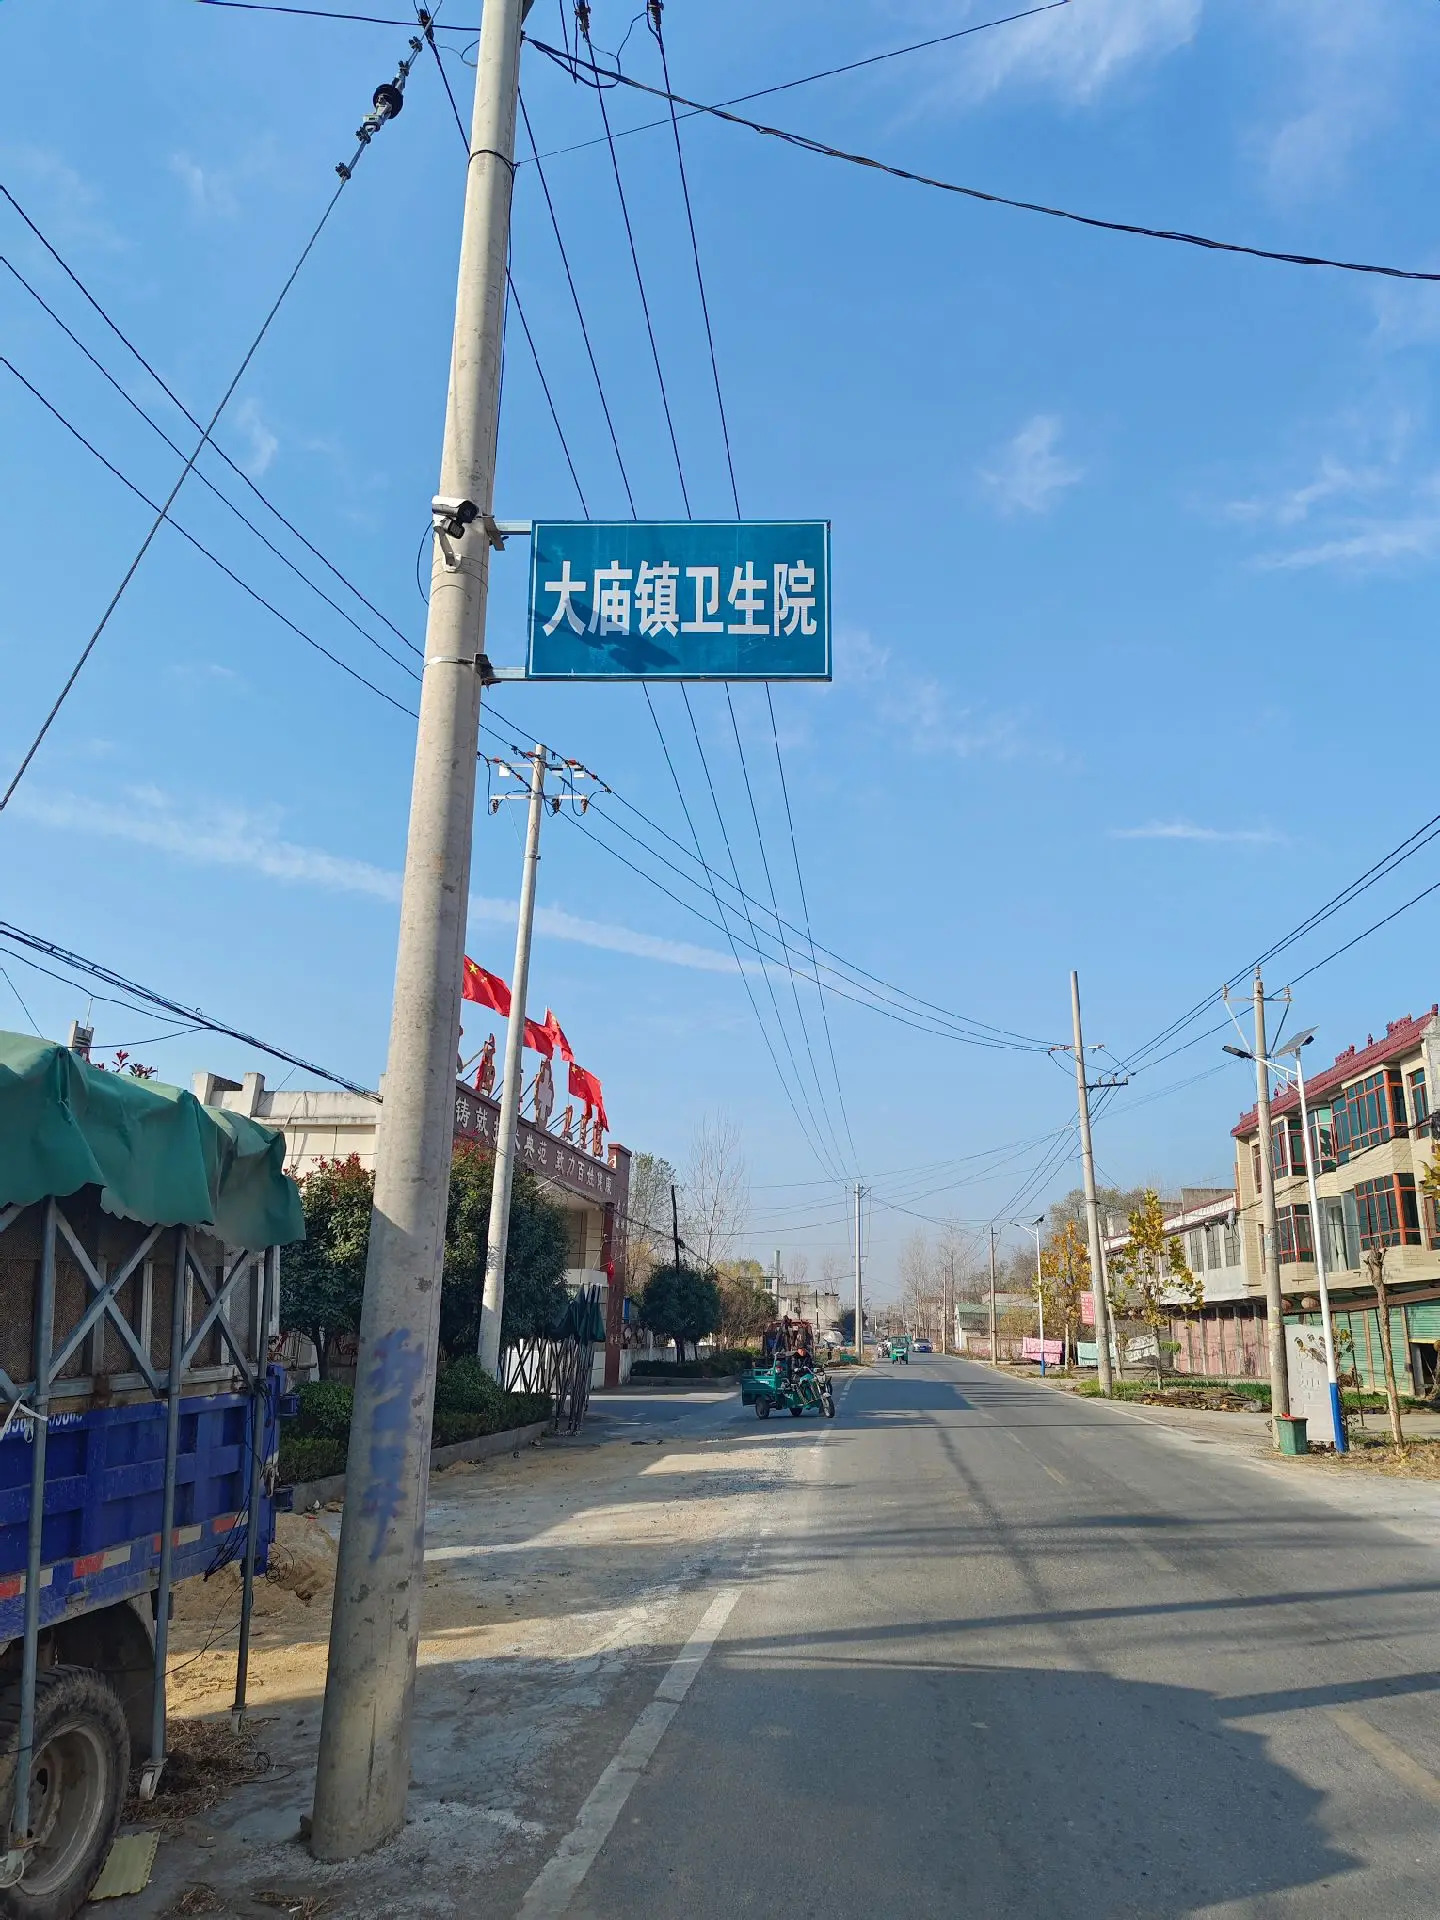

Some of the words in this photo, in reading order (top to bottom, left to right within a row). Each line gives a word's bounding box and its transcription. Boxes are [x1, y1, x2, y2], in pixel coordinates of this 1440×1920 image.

[542, 560, 817, 637] 大庙镇卫生院
